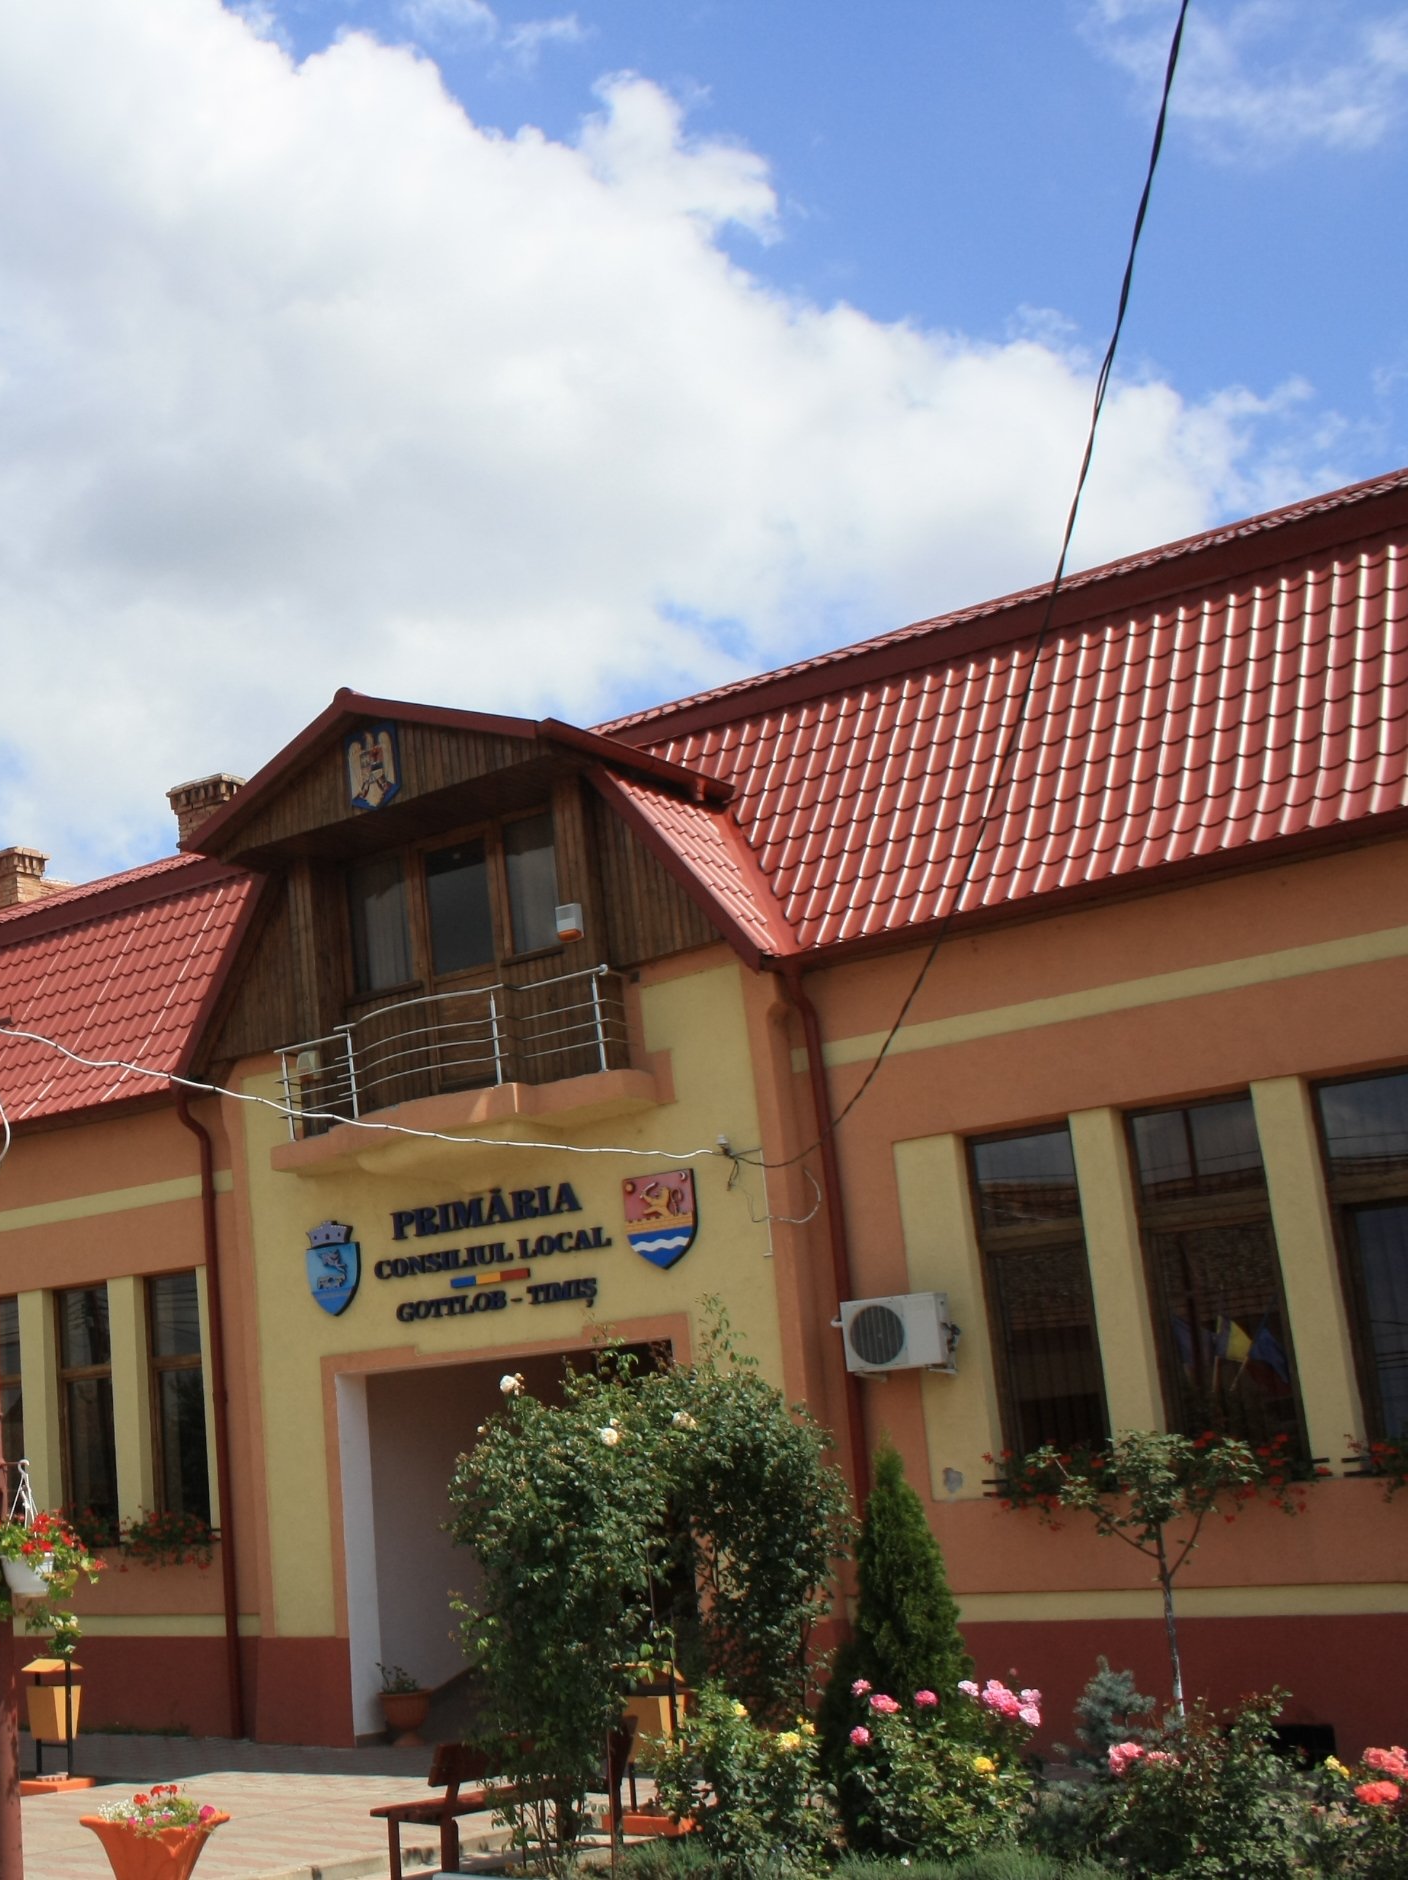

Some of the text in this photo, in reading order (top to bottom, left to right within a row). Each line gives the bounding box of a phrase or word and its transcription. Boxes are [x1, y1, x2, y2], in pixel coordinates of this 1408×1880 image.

[390, 1182, 582, 1240] PRIMĂRIA
[374, 1227, 612, 1279] CONSILIUL LOCAL
[396, 1290, 507, 1322] GOTTLOB
